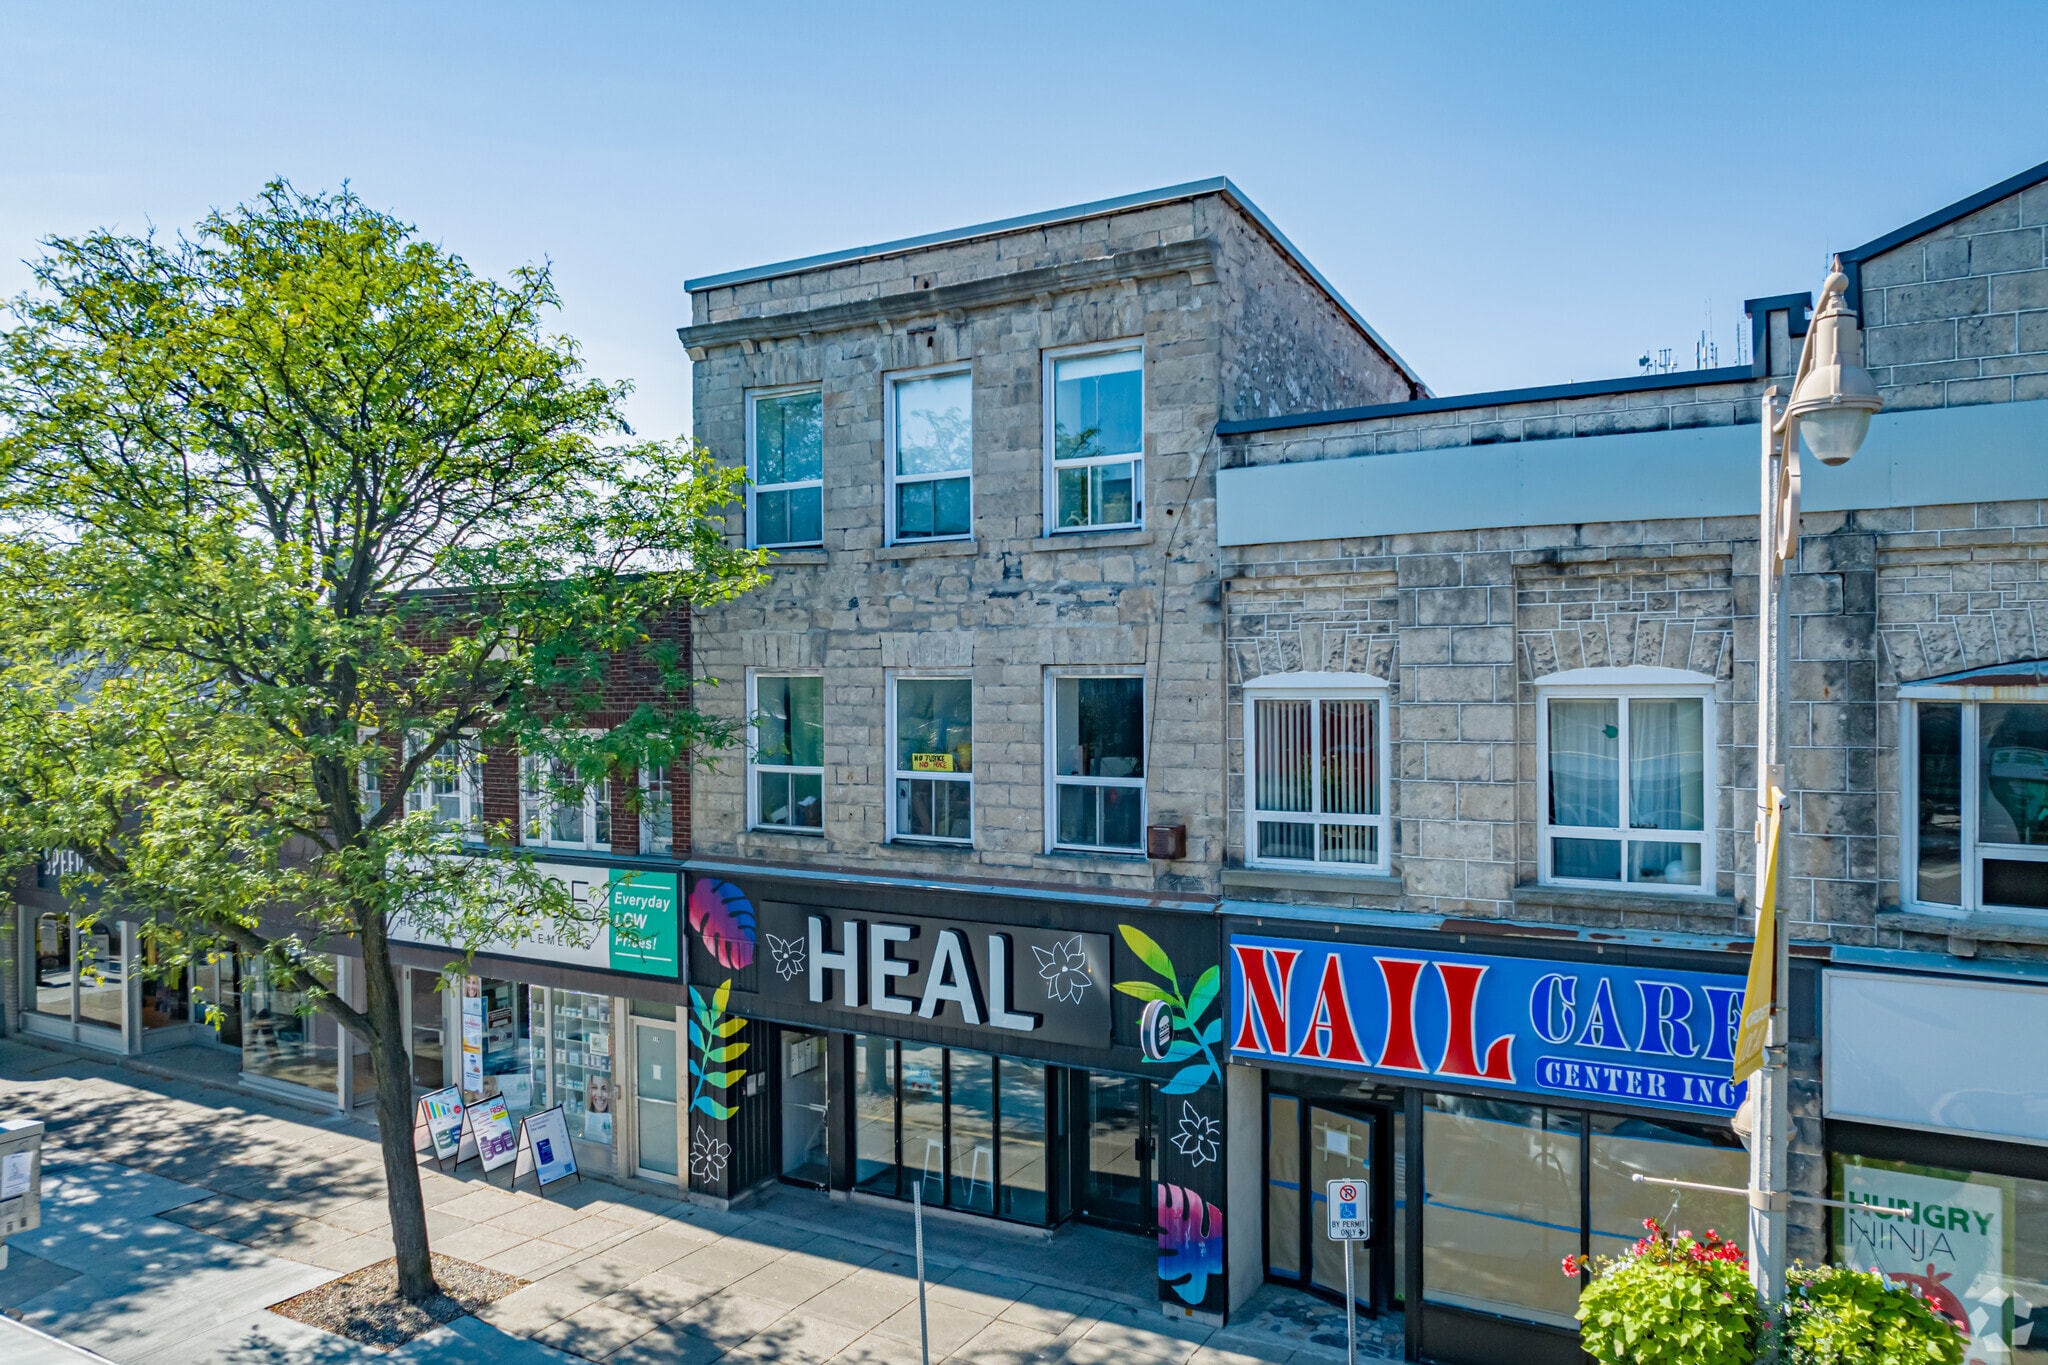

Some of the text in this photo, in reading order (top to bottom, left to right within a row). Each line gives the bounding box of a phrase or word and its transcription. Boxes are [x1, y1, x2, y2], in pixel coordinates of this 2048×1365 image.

[614, 891, 671, 913] Everyday
[614, 911, 648, 930] LOW
[808, 915, 1041, 1032] HEAL
[1230, 944, 1516, 1084] NAIL
[1545, 1061, 1737, 1106] CENTER INC
[490, 1104, 505, 1113] RISK
[1848, 1191, 1995, 1237] HUNGRY
[1850, 1217, 1957, 1263] NINJA
